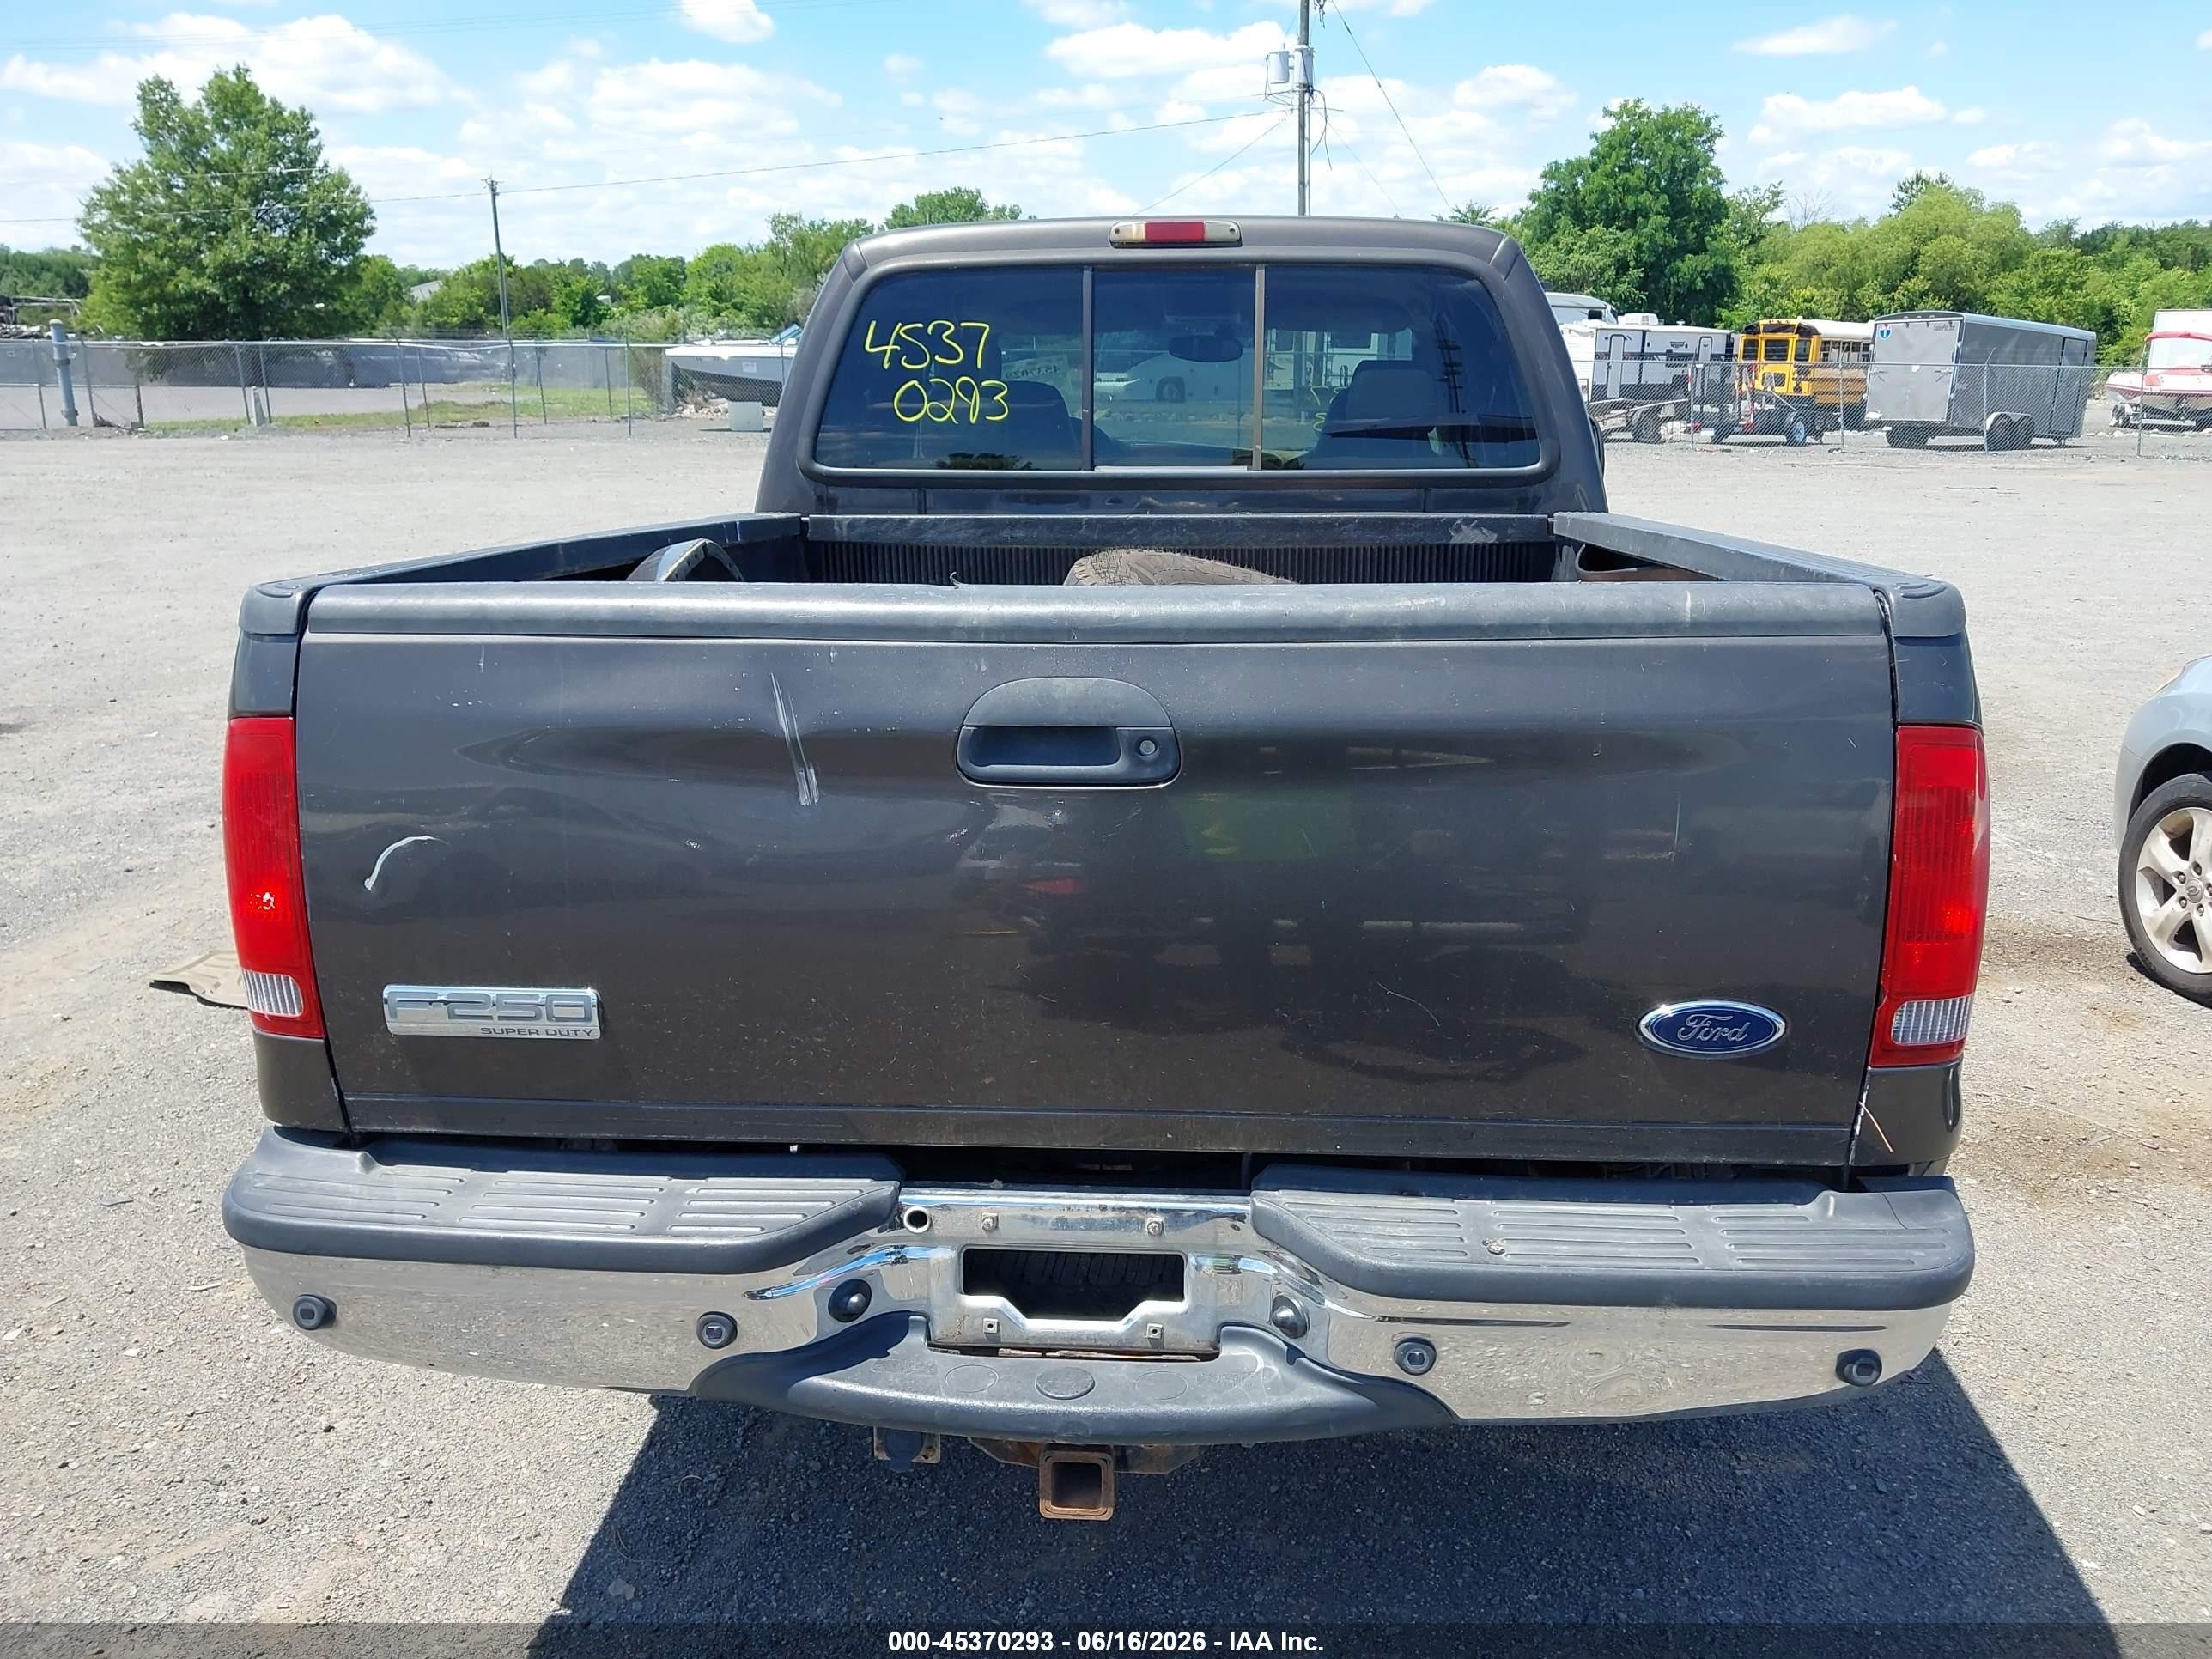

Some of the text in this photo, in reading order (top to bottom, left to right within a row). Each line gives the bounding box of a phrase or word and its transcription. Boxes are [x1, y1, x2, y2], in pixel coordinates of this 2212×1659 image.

[865, 319, 990, 369] 4537
[894, 376, 1009, 424] 0293
[480, 1027, 593, 1037] SUPER DUTY
[1677, 1013, 1752, 1042] Ford
